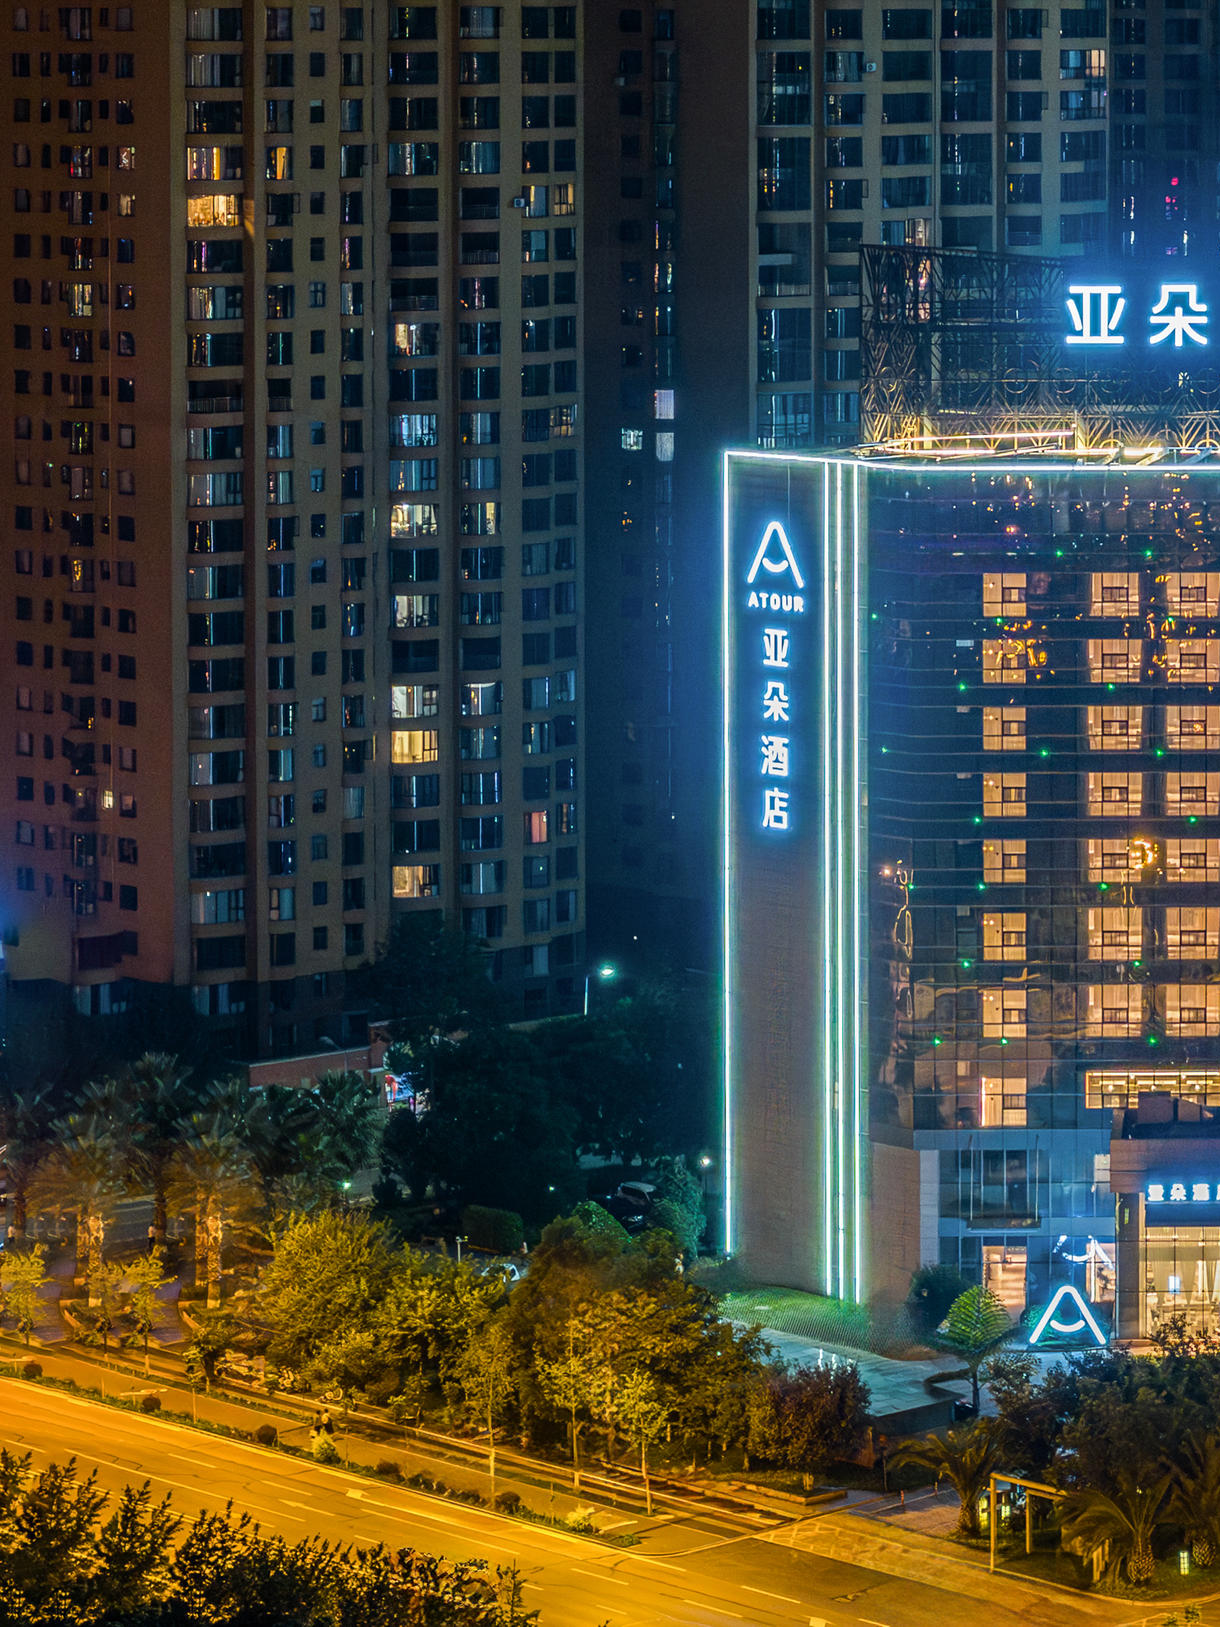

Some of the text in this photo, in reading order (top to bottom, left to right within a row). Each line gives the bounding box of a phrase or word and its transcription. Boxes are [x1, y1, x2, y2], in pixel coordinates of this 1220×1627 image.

[747, 591, 804, 612] ATOUR
[761, 628, 790, 830] 亚朵酒店
